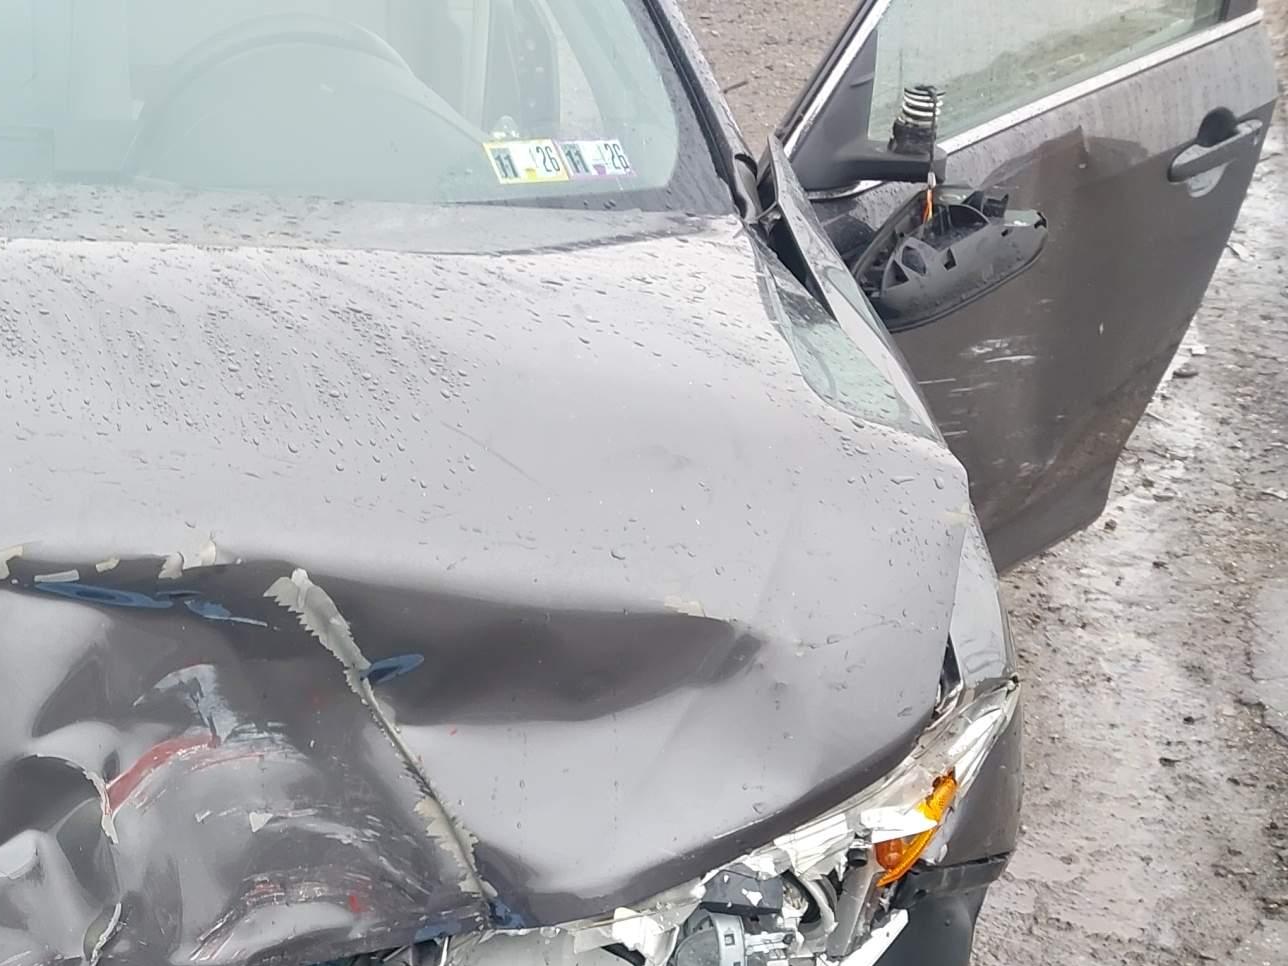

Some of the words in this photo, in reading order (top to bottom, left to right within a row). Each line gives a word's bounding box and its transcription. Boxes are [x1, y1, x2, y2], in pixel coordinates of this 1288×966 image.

[494, 153, 520, 179] 11
[536, 145, 561, 173] 26
[565, 149, 590, 174] 11
[604, 143, 629, 169] 26
